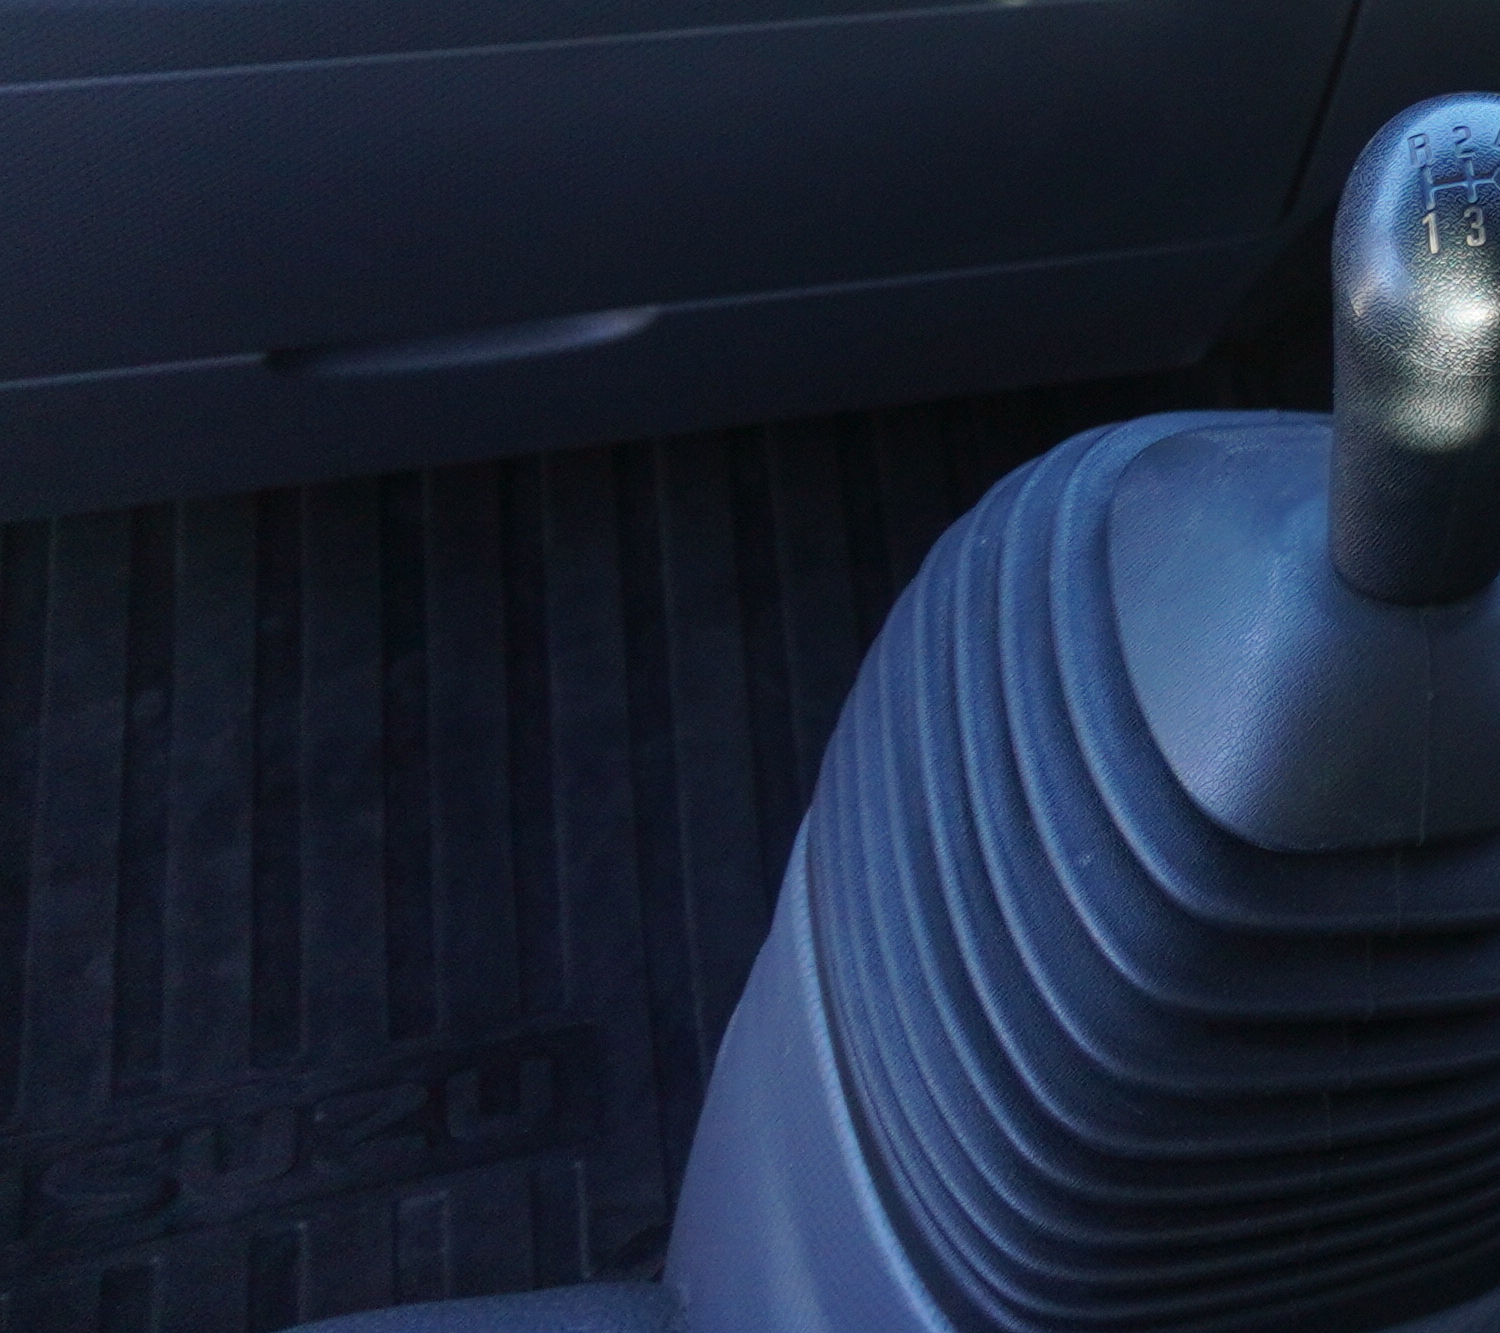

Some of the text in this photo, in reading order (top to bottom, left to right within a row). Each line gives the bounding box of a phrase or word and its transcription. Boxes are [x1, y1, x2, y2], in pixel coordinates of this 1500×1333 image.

[1406, 133, 1434, 168] R
[1452, 125, 1477, 156] 2
[1421, 211, 1440, 255] 1
[1463, 206, 1487, 248] 3
